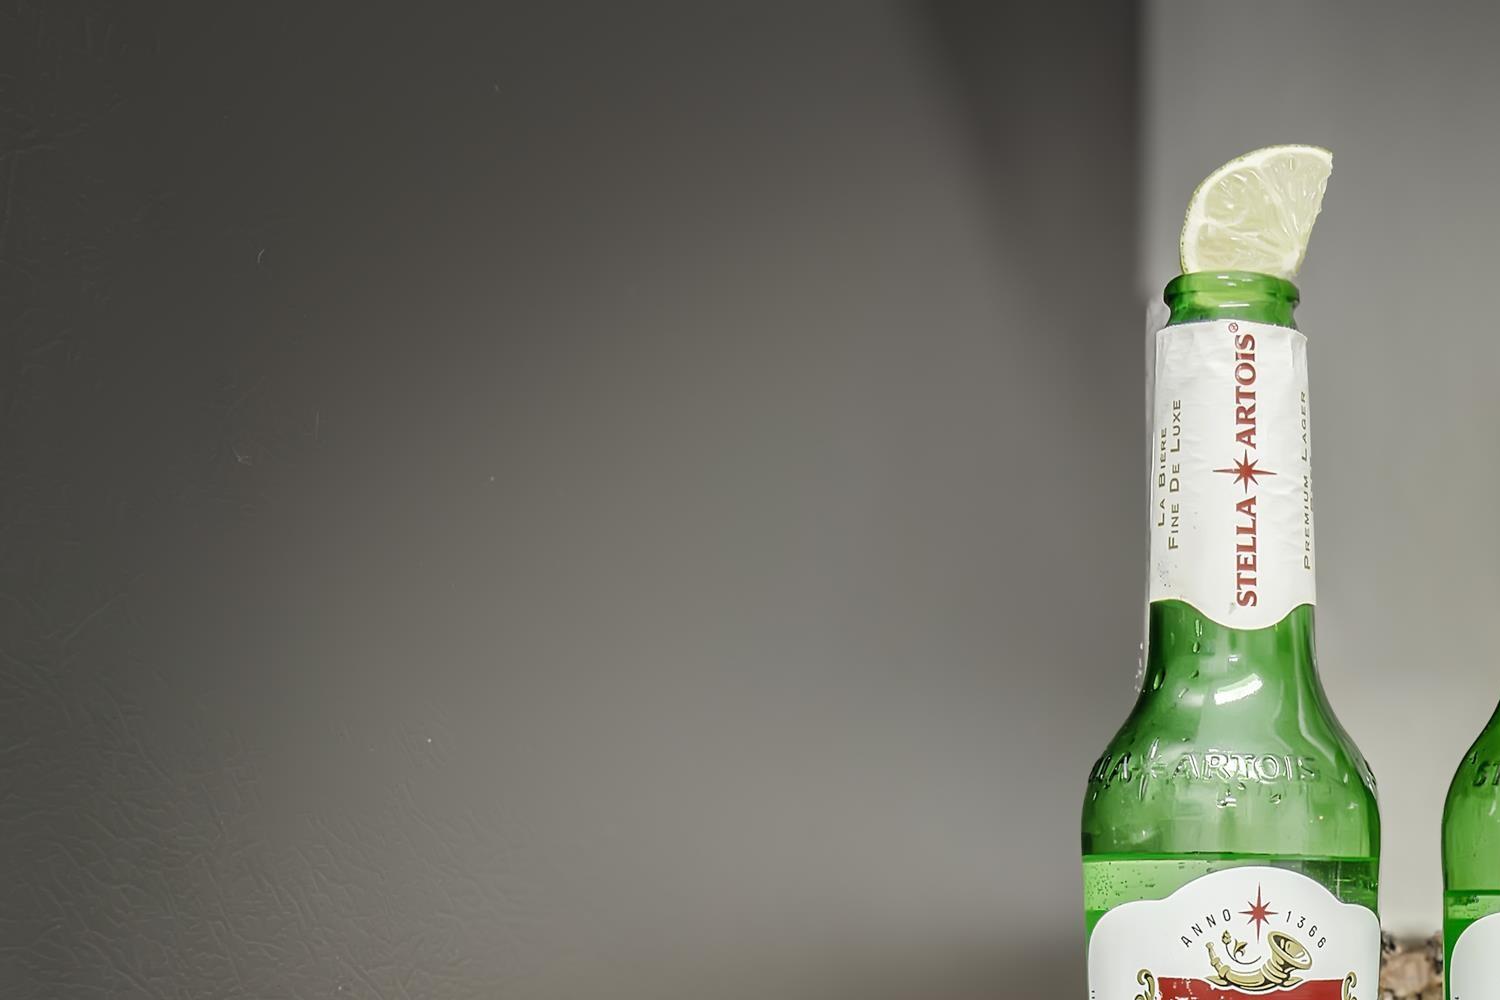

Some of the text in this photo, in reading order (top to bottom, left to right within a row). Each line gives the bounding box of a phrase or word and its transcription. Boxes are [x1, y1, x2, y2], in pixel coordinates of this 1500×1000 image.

[1168, 400, 1182, 550] FINE DE LUXE
[1234, 334, 1258, 607] STELLA ARTOIS
[1181, 908, 1327, 949] ANNO 1366
